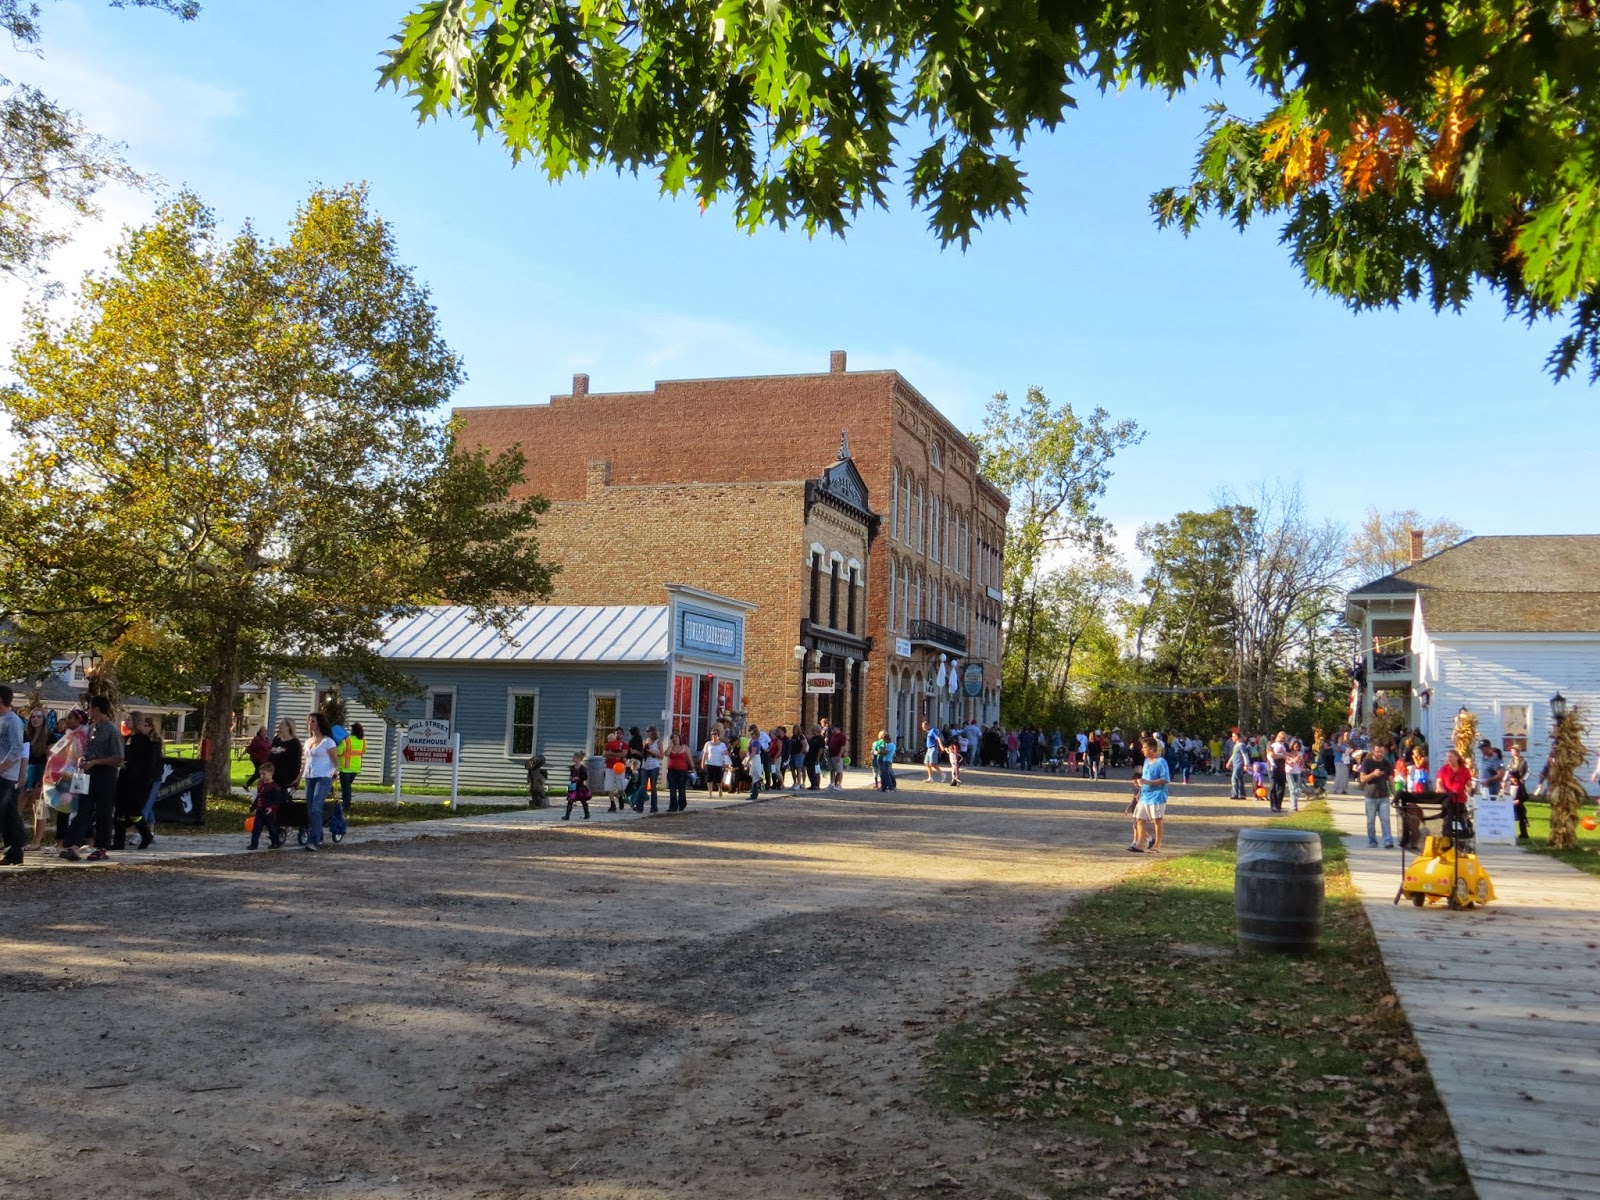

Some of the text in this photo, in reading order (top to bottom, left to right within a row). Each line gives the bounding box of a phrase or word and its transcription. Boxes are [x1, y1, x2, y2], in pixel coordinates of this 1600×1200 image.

[686, 620, 704, 641] FOWLER
[809, 679, 833, 687] DENTIST
[409, 720, 448, 732] MILL STREET
